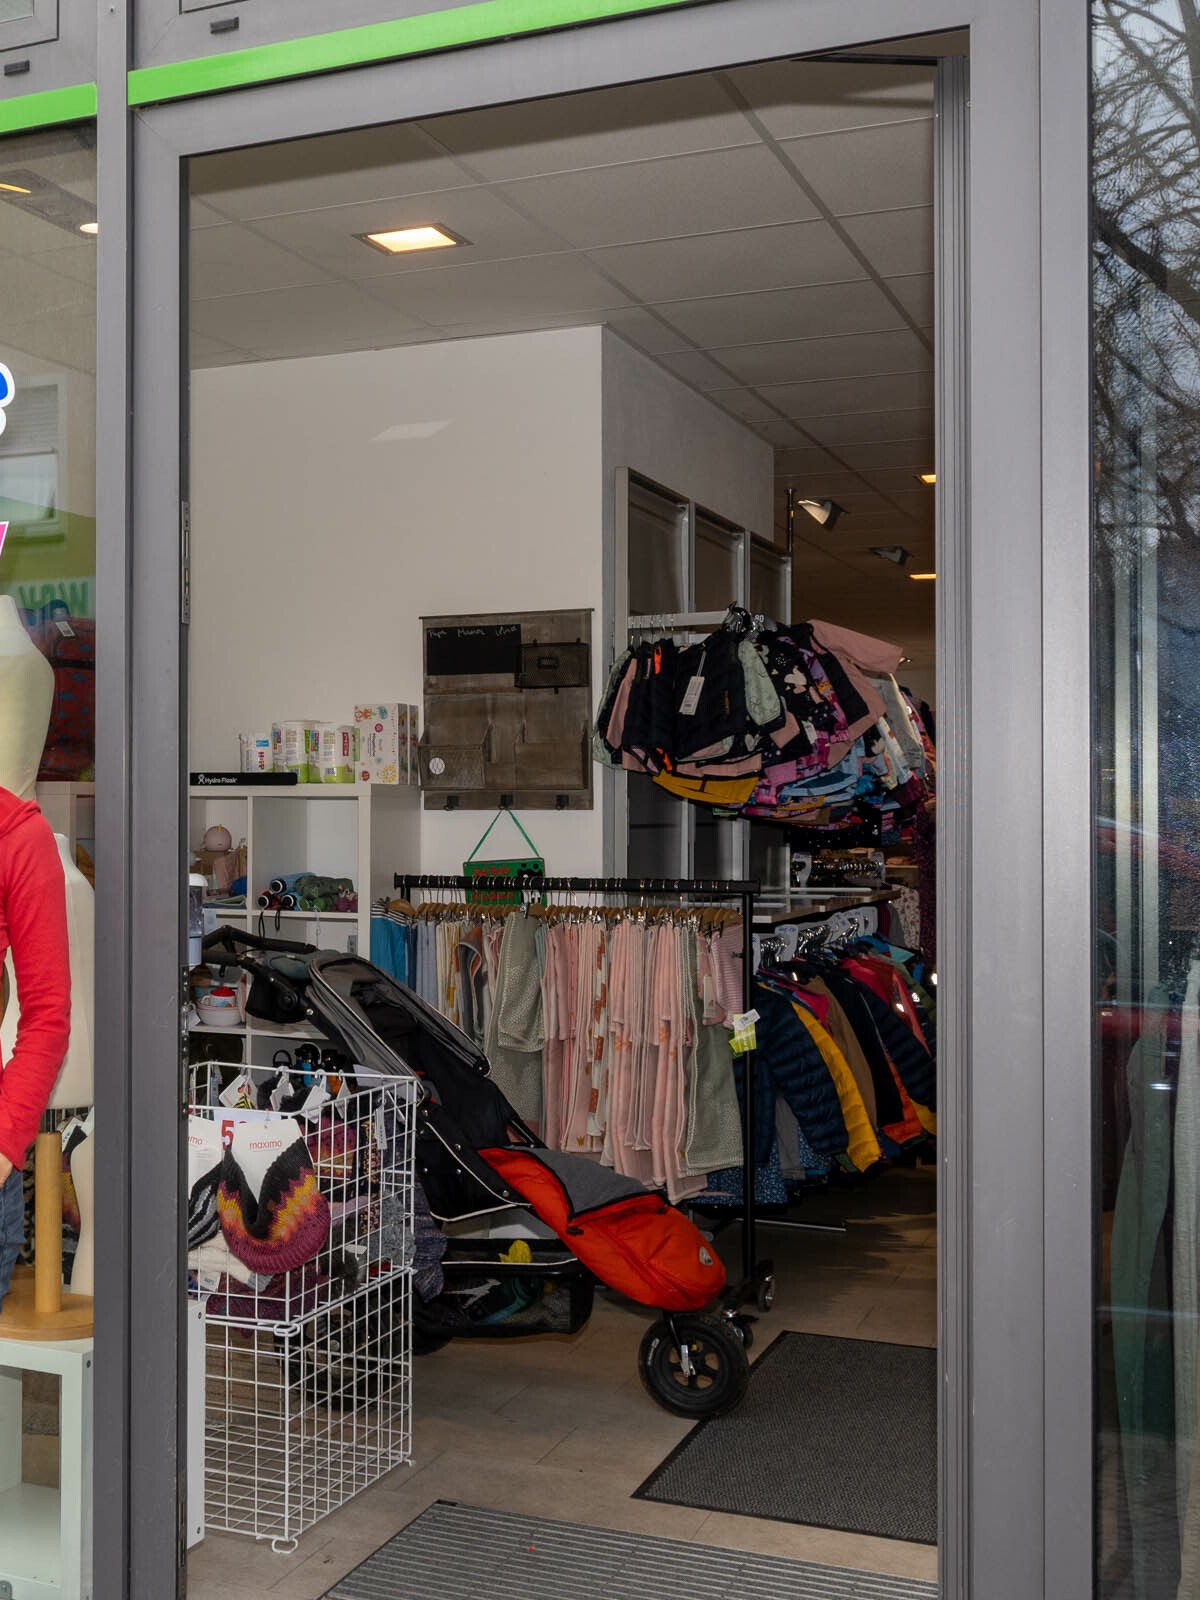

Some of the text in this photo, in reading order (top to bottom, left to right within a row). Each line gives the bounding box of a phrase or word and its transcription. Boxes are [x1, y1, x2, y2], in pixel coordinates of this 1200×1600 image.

[205, 777, 221, 785] Hydro
[187, 1135, 203, 1145] imo
[249, 1139, 282, 1150] maximo
